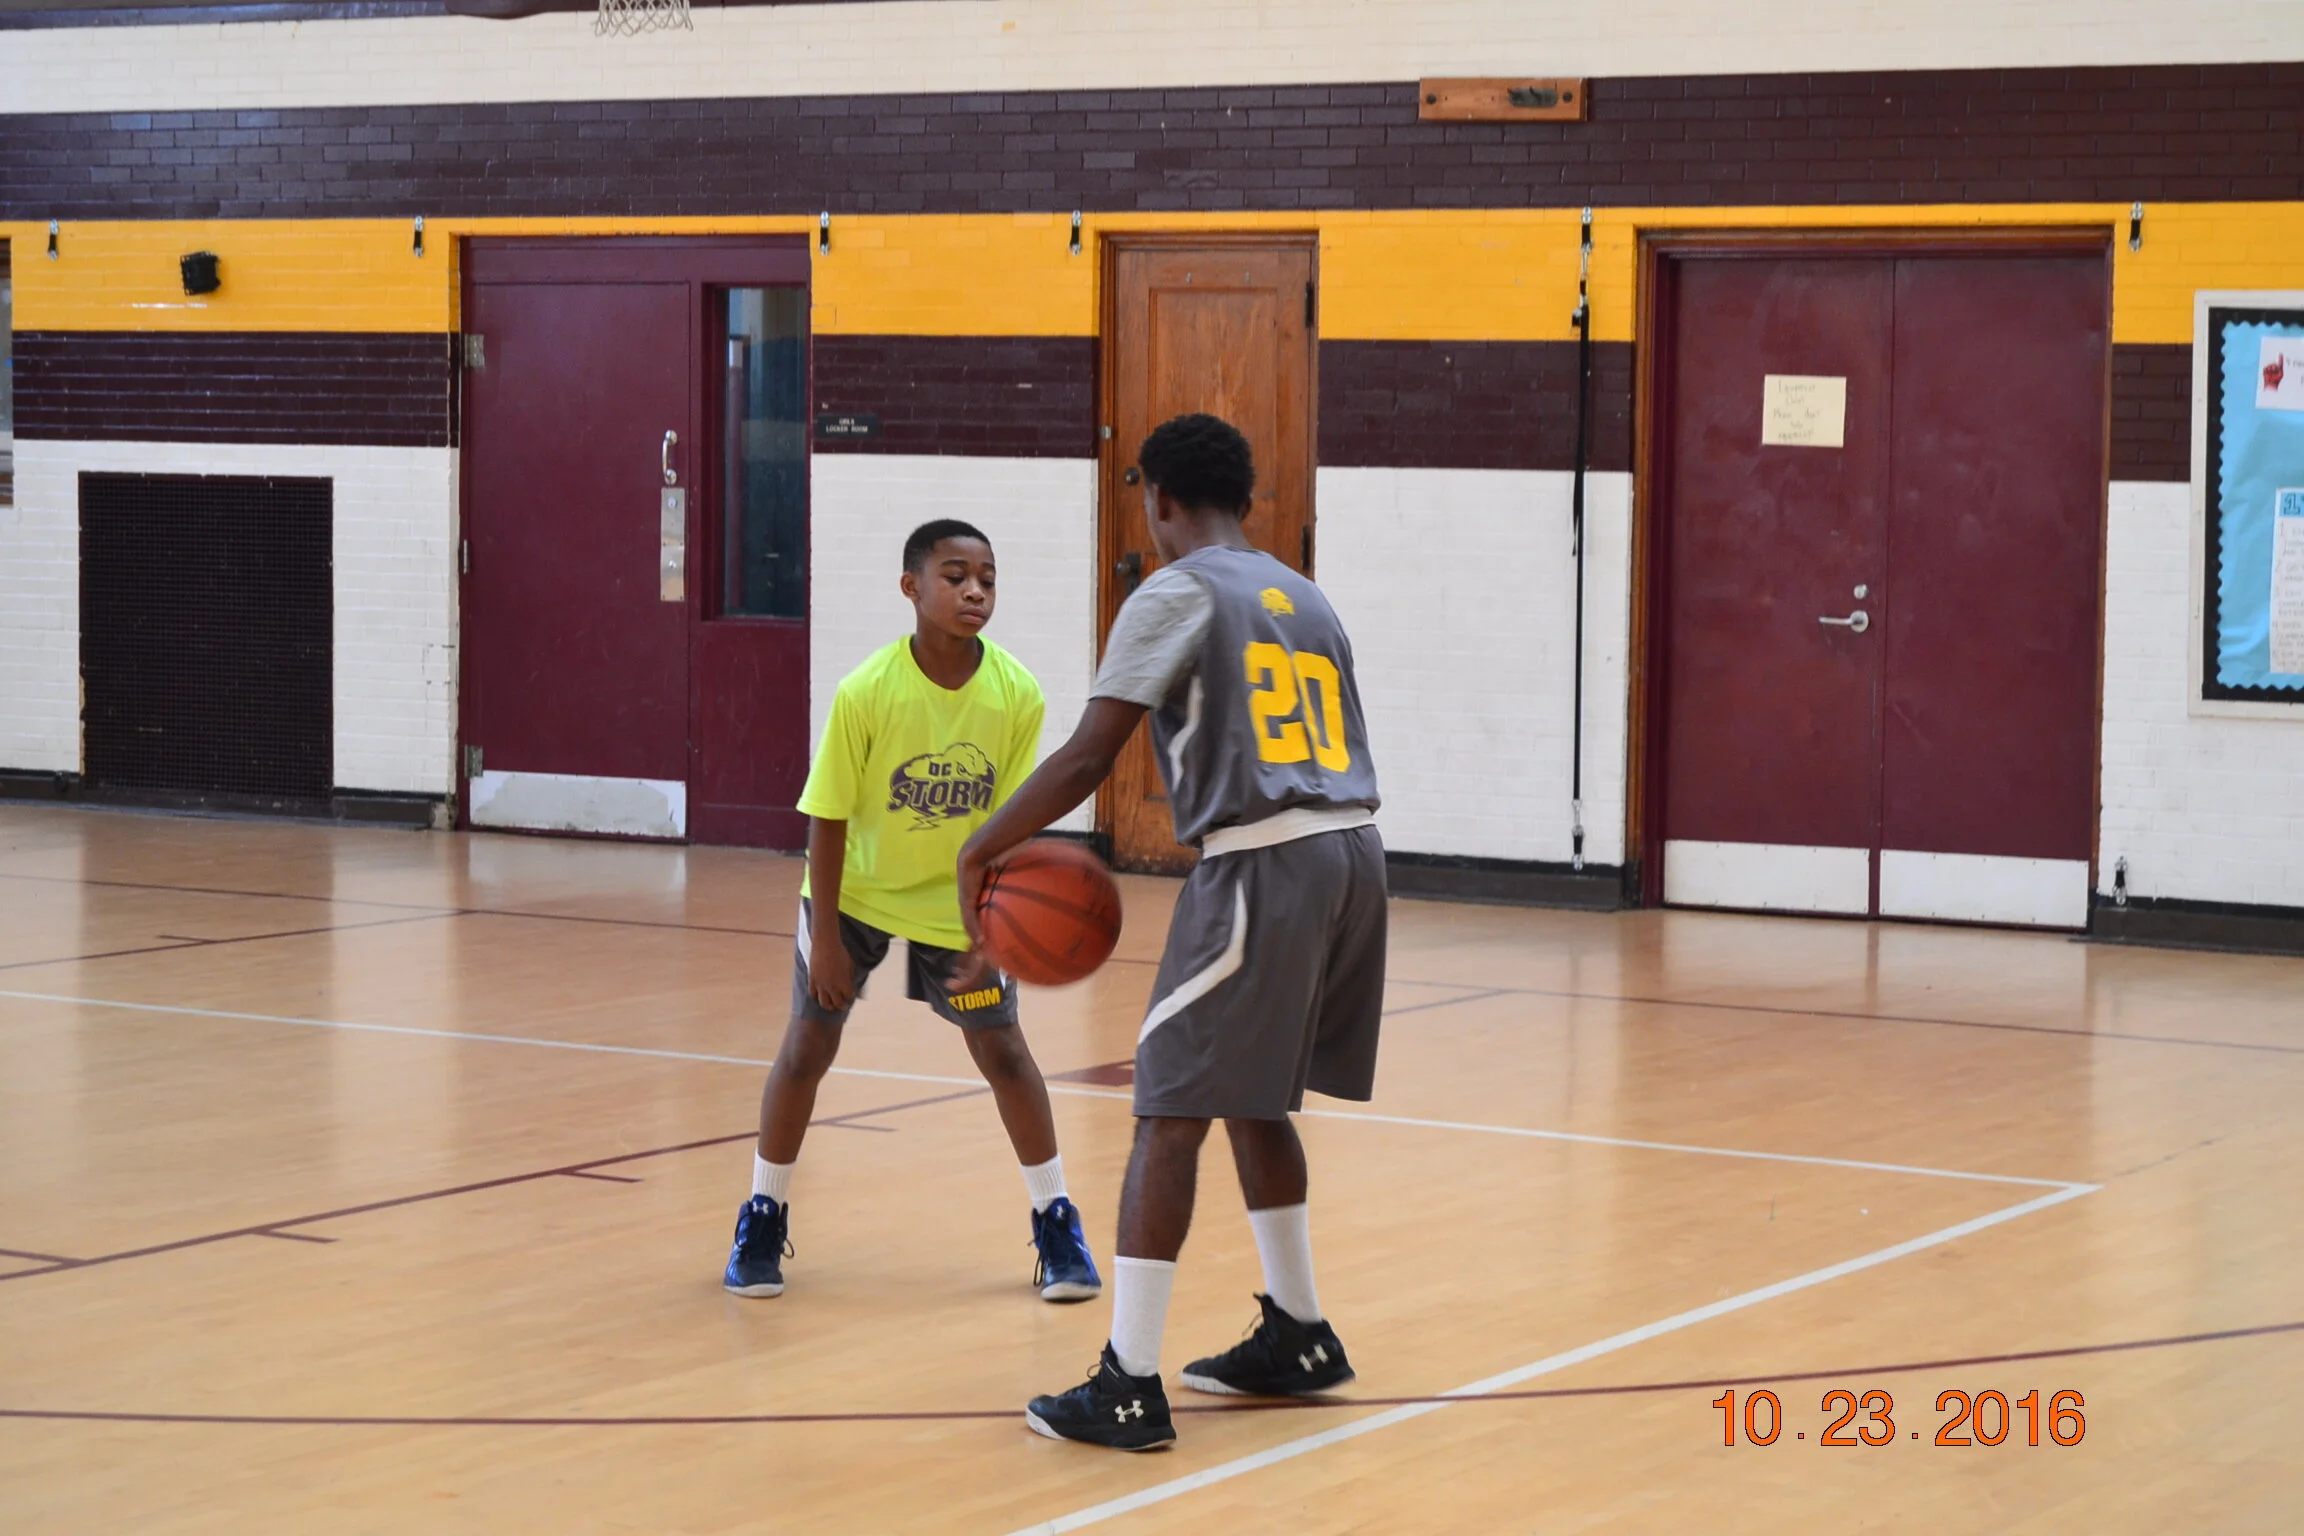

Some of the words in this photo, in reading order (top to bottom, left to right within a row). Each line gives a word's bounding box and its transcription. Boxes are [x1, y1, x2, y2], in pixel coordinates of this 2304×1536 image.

[1243, 641, 1351, 773] 20
[928, 761, 952, 776] DC
[886, 778, 994, 813] STORM
